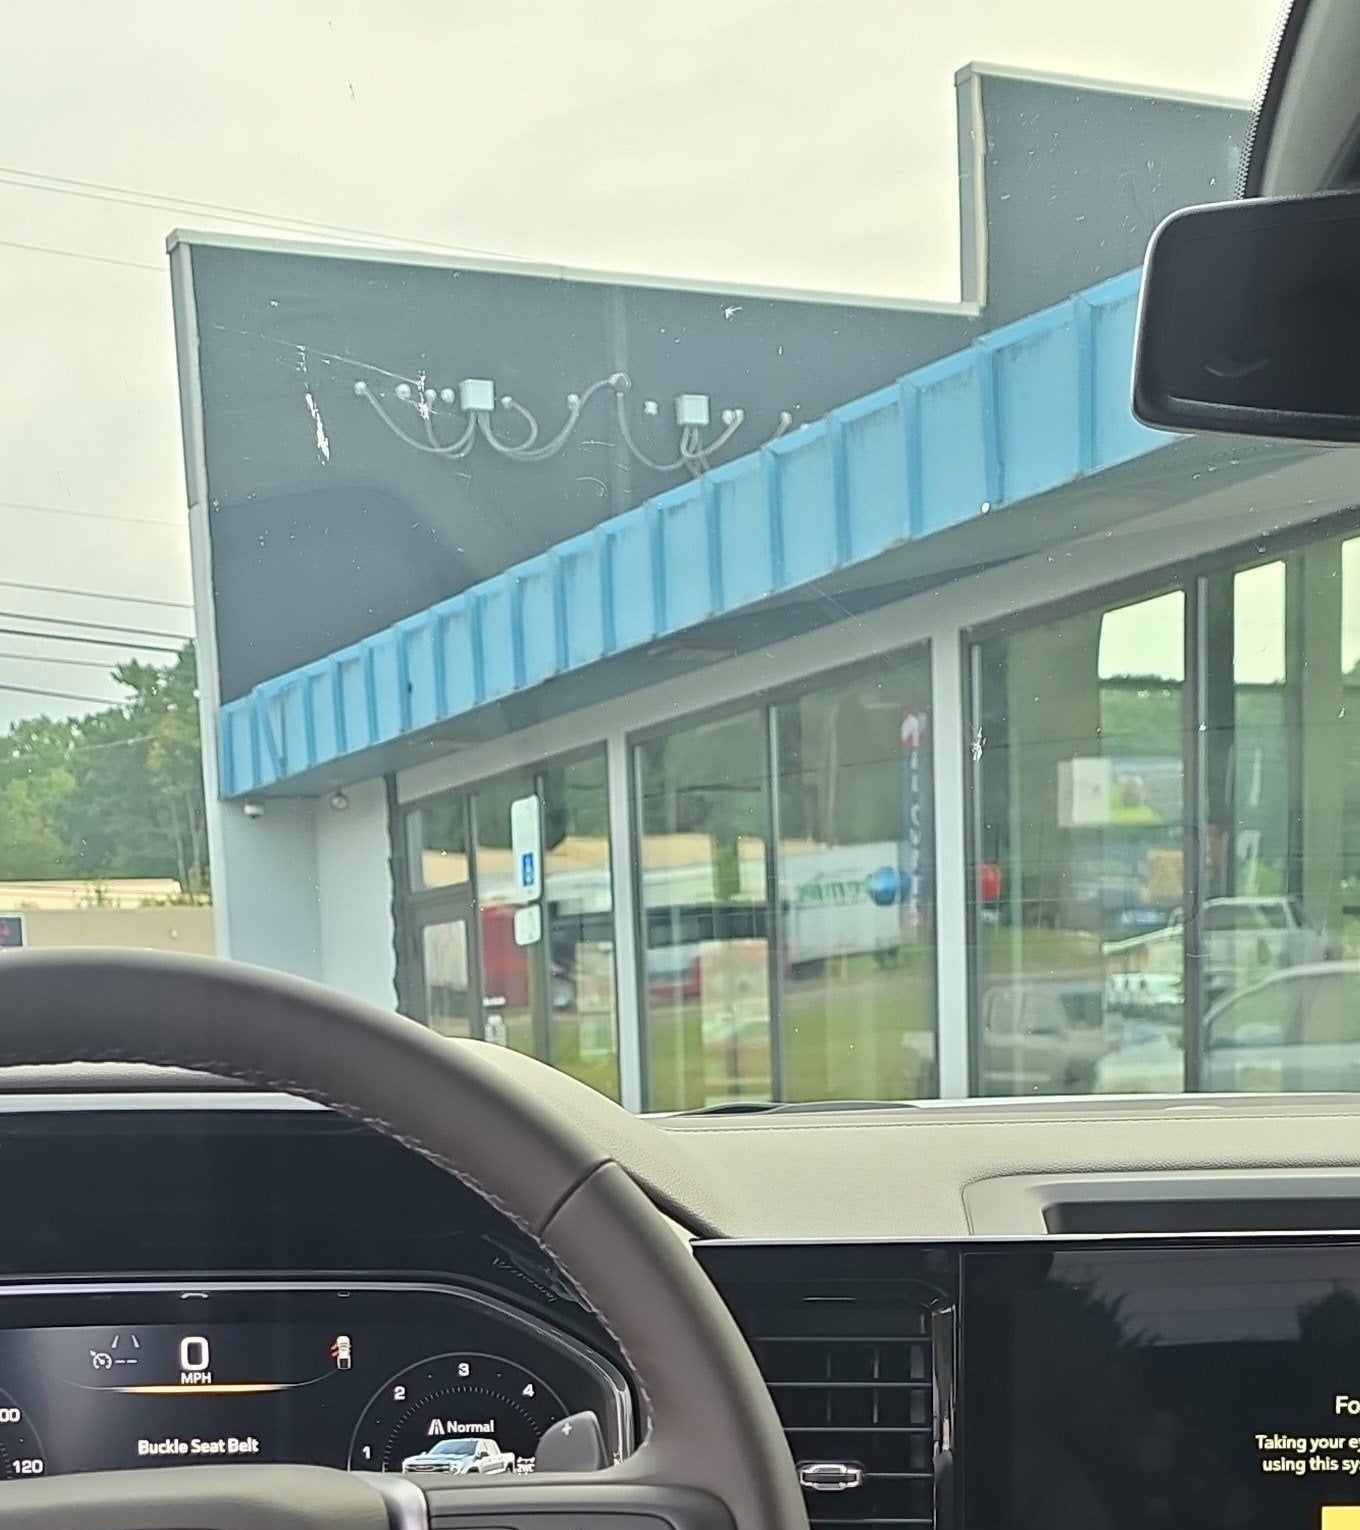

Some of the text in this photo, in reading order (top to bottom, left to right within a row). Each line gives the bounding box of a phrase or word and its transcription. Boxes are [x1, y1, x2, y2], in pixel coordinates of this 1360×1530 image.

[180, 1336, 210, 1371] 0
[458, 1362, 470, 1377] 3
[180, 1371, 212, 1385] MPH
[393, 1385, 406, 1400] 2
[522, 1383, 535, 1398] 4
[446, 1419, 495, 1434] Normal
[137, 1436, 260, 1456] Buckle Seat Belt
[1254, 1433, 1307, 1454] Taking
[1308, 1437, 1347, 1454] your
[362, 1445, 371, 1459] 1
[12, 1459, 44, 1475] 120
[1262, 1456, 1306, 1476] using
[1308, 1455, 1340, 1471] this
